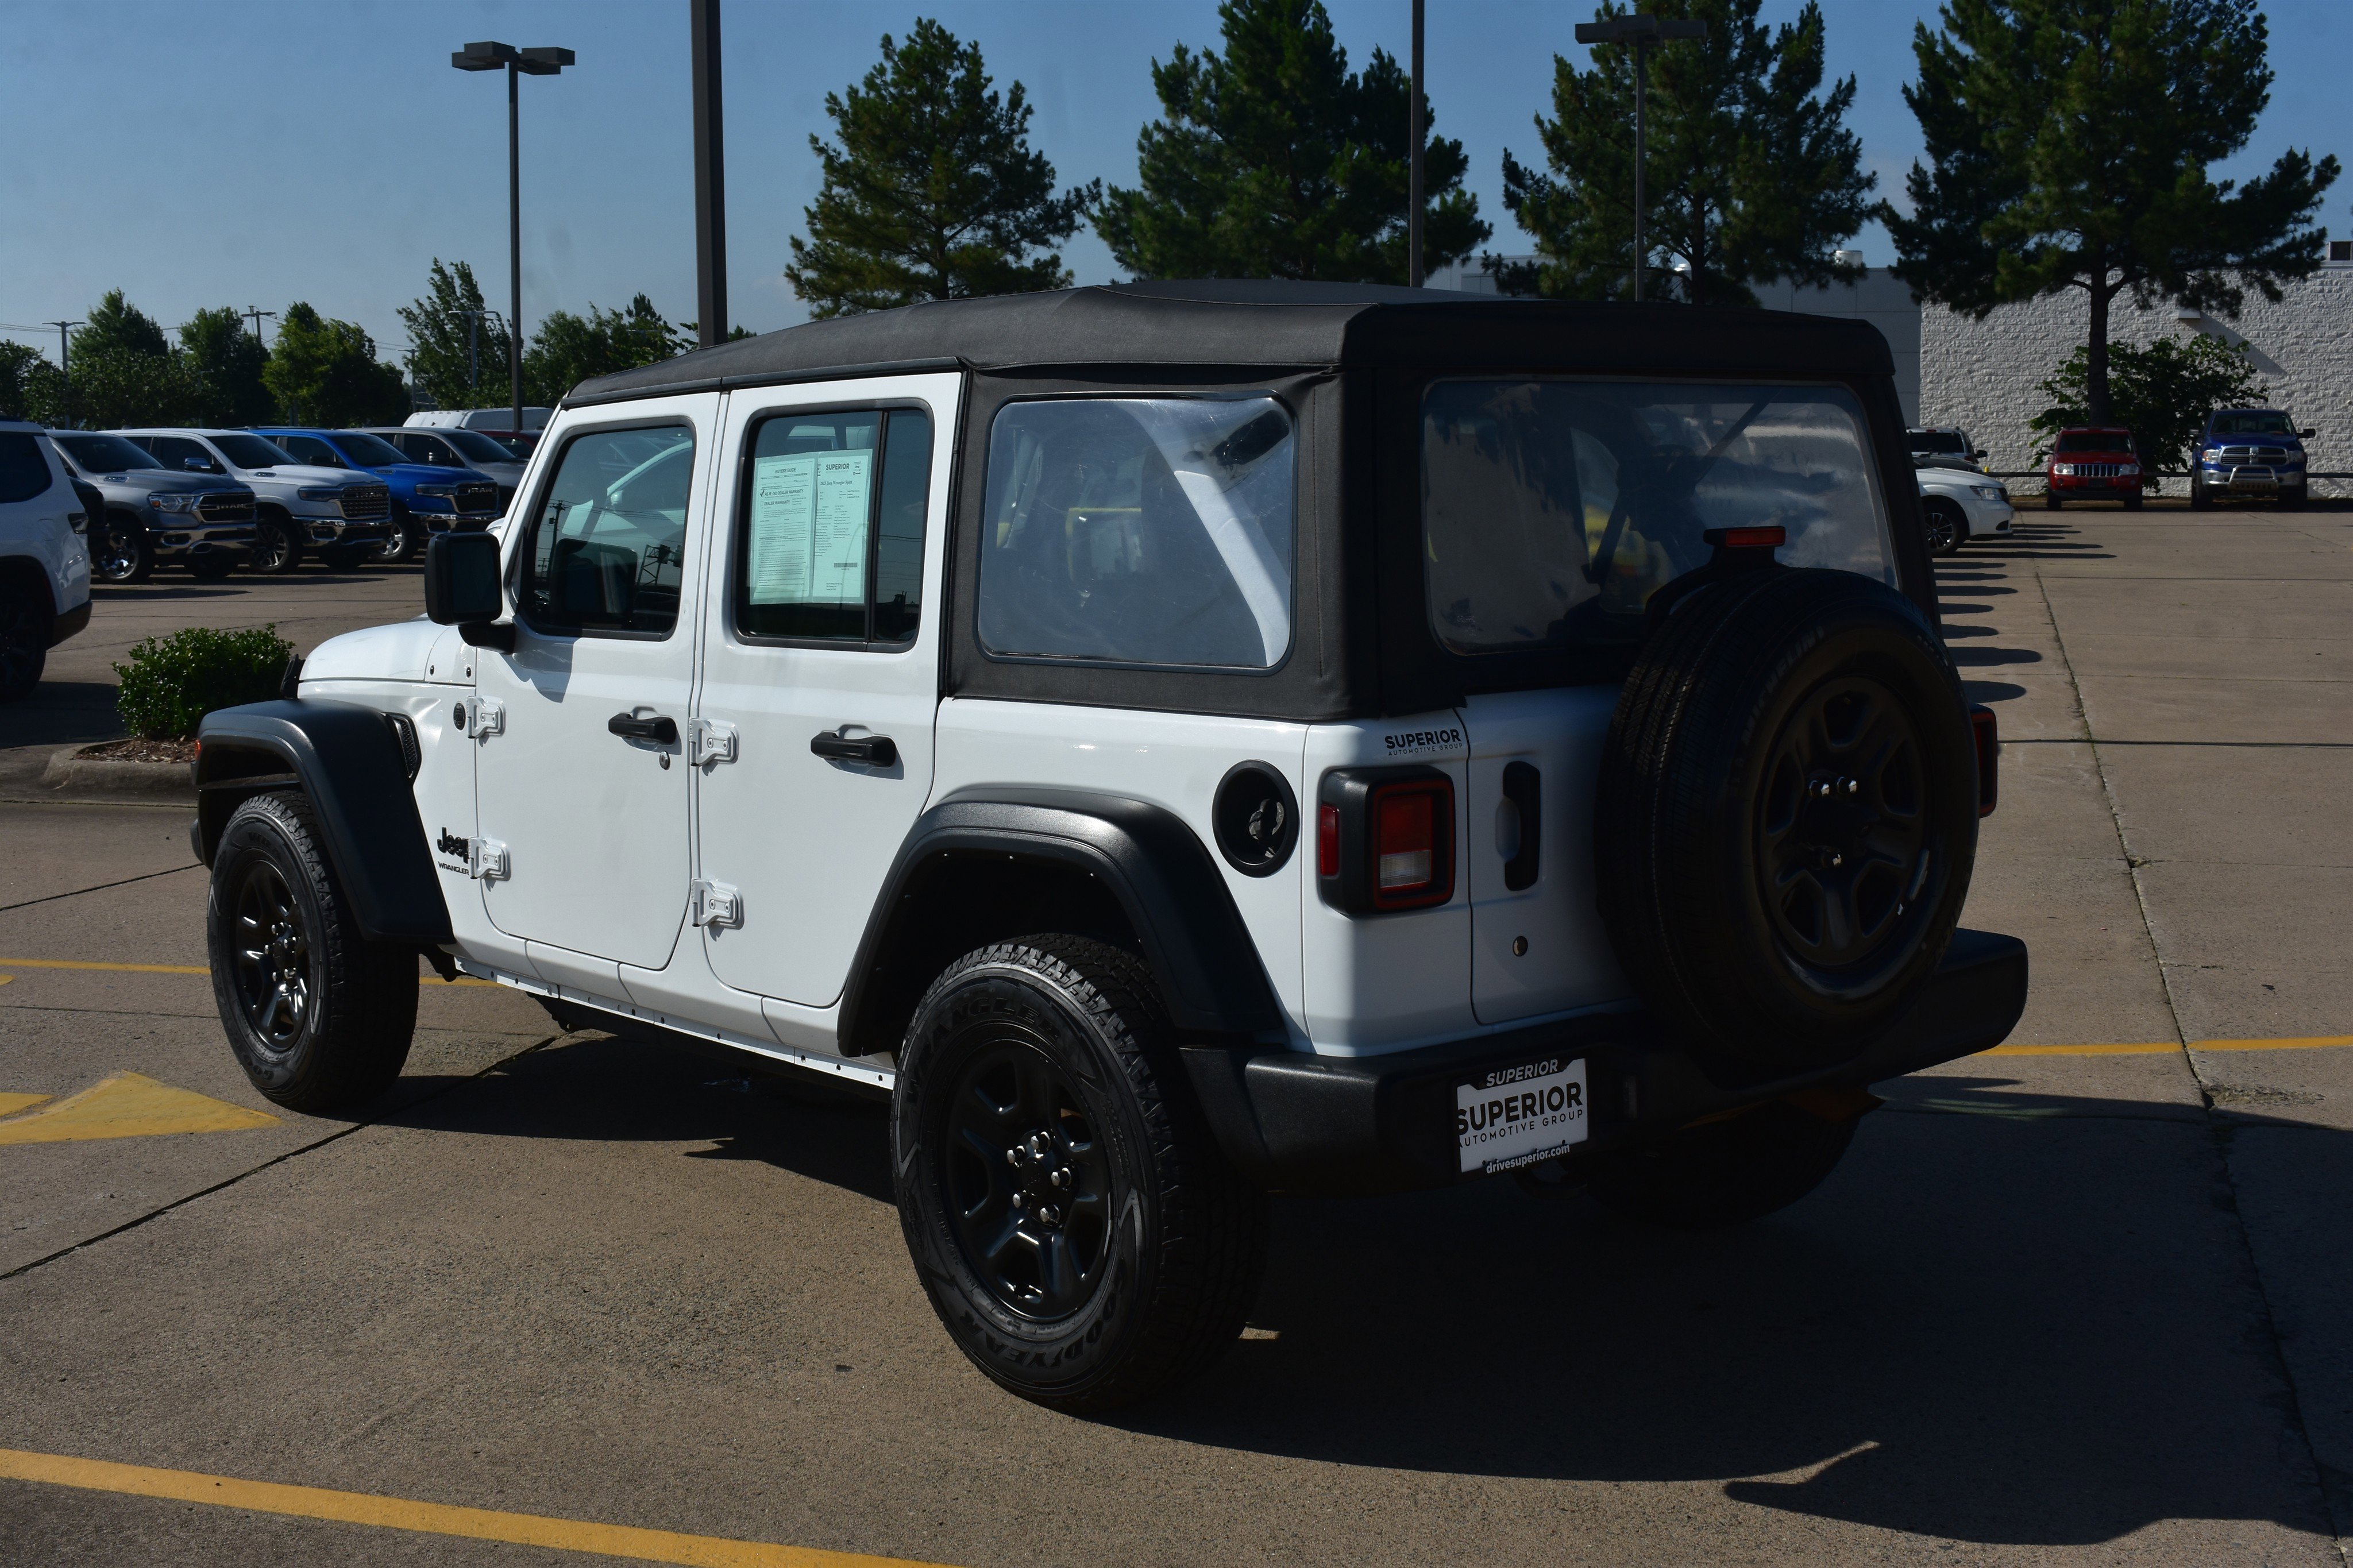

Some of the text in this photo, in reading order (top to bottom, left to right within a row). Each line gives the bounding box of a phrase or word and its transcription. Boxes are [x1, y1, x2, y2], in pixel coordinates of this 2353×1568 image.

[1384, 729, 1461, 750] SUPERIOR
[1388, 743, 1463, 756] AUTOMOTIVE GROUP
[437, 827, 469, 864] Jeep
[437, 861, 470, 875] WRANGLER
[905, 997, 1062, 1107] WRANGLER
[1486, 1059, 1559, 1087] SUPERIOR
[1457, 1082, 1583, 1136] SUPERIOR
[1542, 1109, 1583, 1127] GROUP
[1486, 1144, 1571, 1174] drivesuperior.com
[959, 1256, 1128, 1369] GOODYEAR
